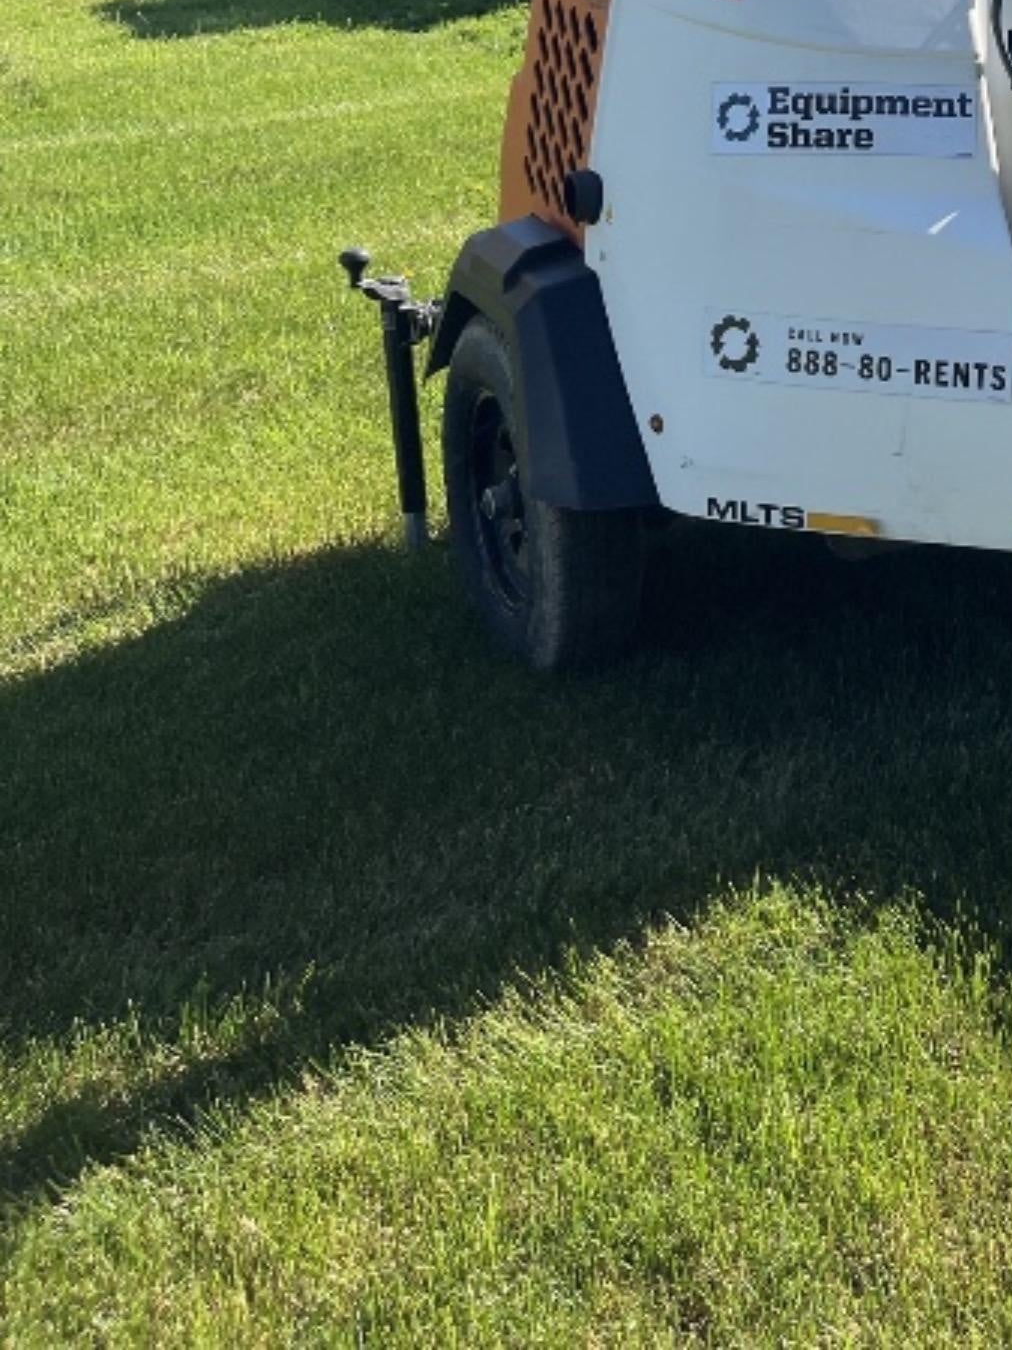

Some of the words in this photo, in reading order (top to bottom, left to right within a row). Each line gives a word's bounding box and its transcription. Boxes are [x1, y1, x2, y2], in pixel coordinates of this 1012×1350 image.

[767, 86, 973, 121] Equipment
[767, 122, 874, 149] Share
[786, 347, 1007, 392] 888-80-RENTS
[707, 497, 805, 528] MLTS
